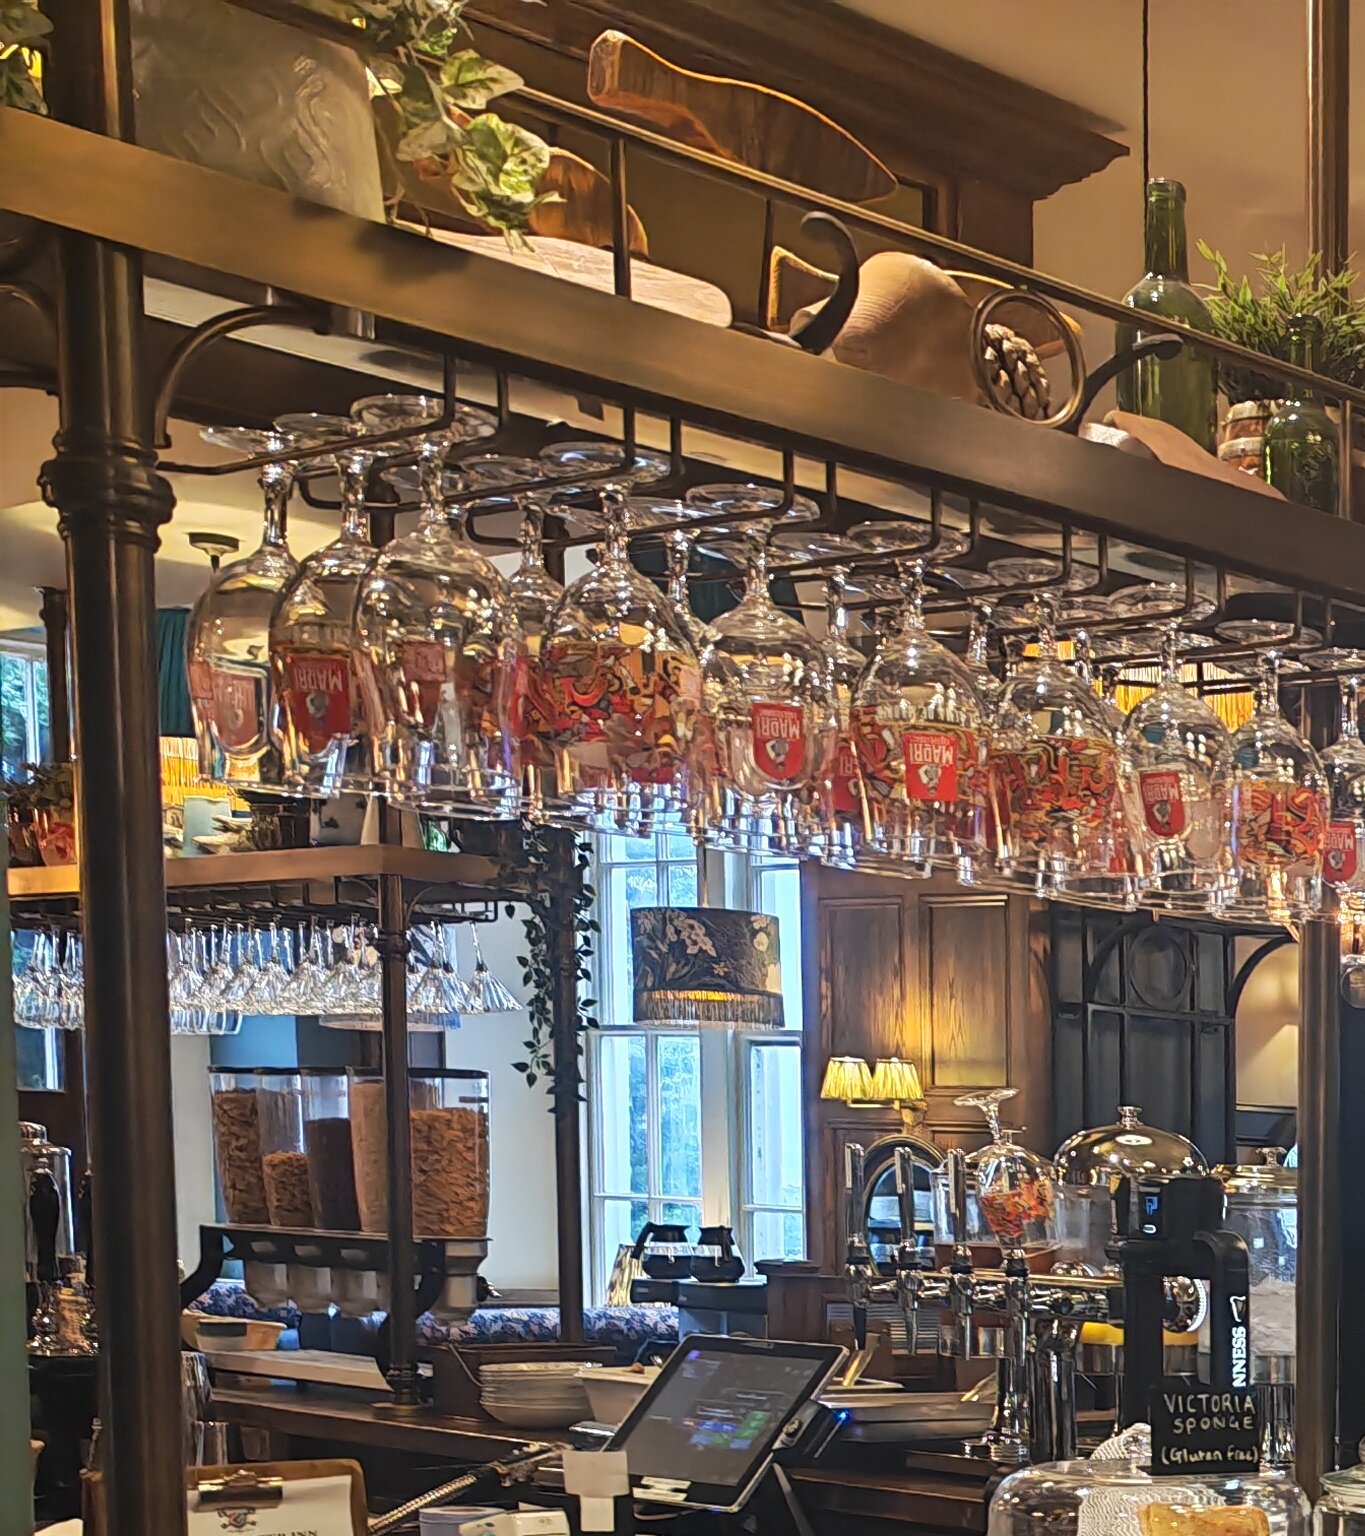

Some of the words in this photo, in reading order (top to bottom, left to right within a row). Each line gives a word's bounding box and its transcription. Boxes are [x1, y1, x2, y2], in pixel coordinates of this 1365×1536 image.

[1232, 1326, 1247, 1387] NNESS
[1163, 1394, 1256, 1414] VICTORIA
[1173, 1416, 1254, 1435] SPONGE
